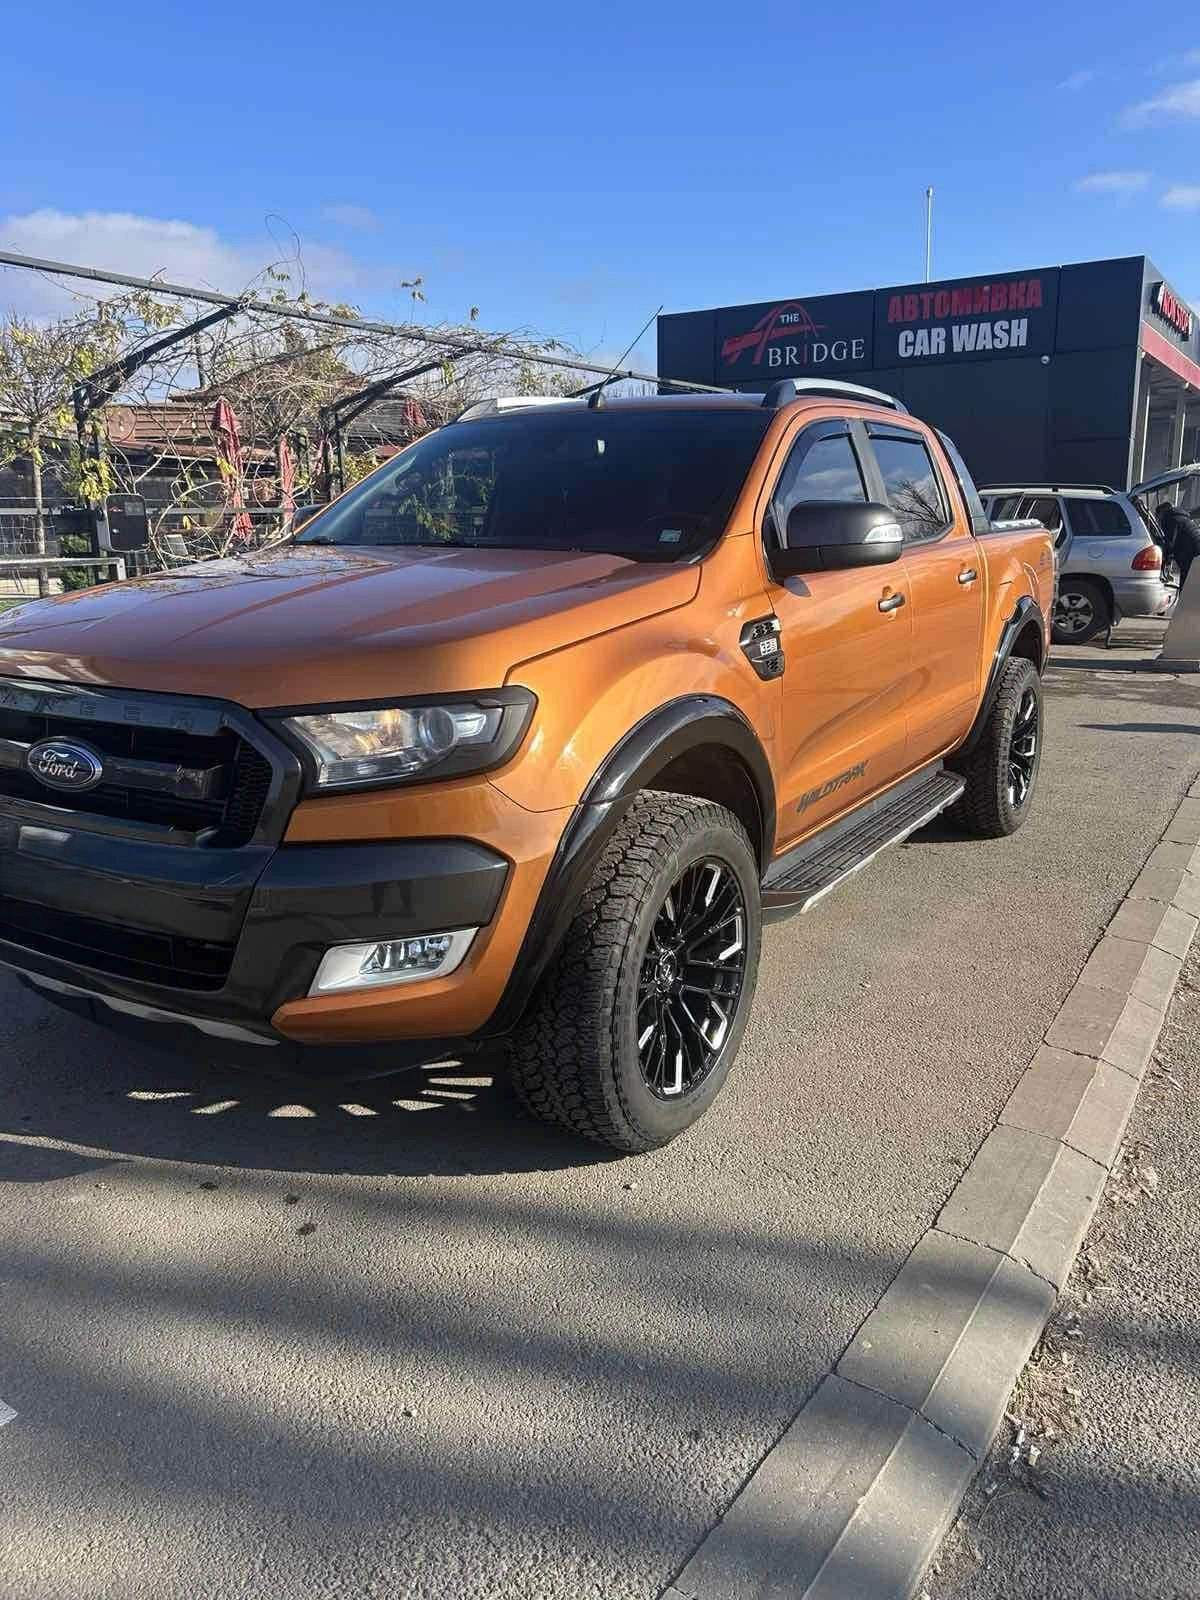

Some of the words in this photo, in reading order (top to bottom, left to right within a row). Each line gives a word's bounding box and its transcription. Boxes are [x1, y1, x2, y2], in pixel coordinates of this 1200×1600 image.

[888, 279, 1042, 323] АВТОМИВКА
[780, 313, 801, 324] THE
[768, 338, 865, 367] BRIDGE
[899, 327, 946, 358] CAR
[951, 318, 1028, 353] WASH
[37, 749, 79, 779] Ford
